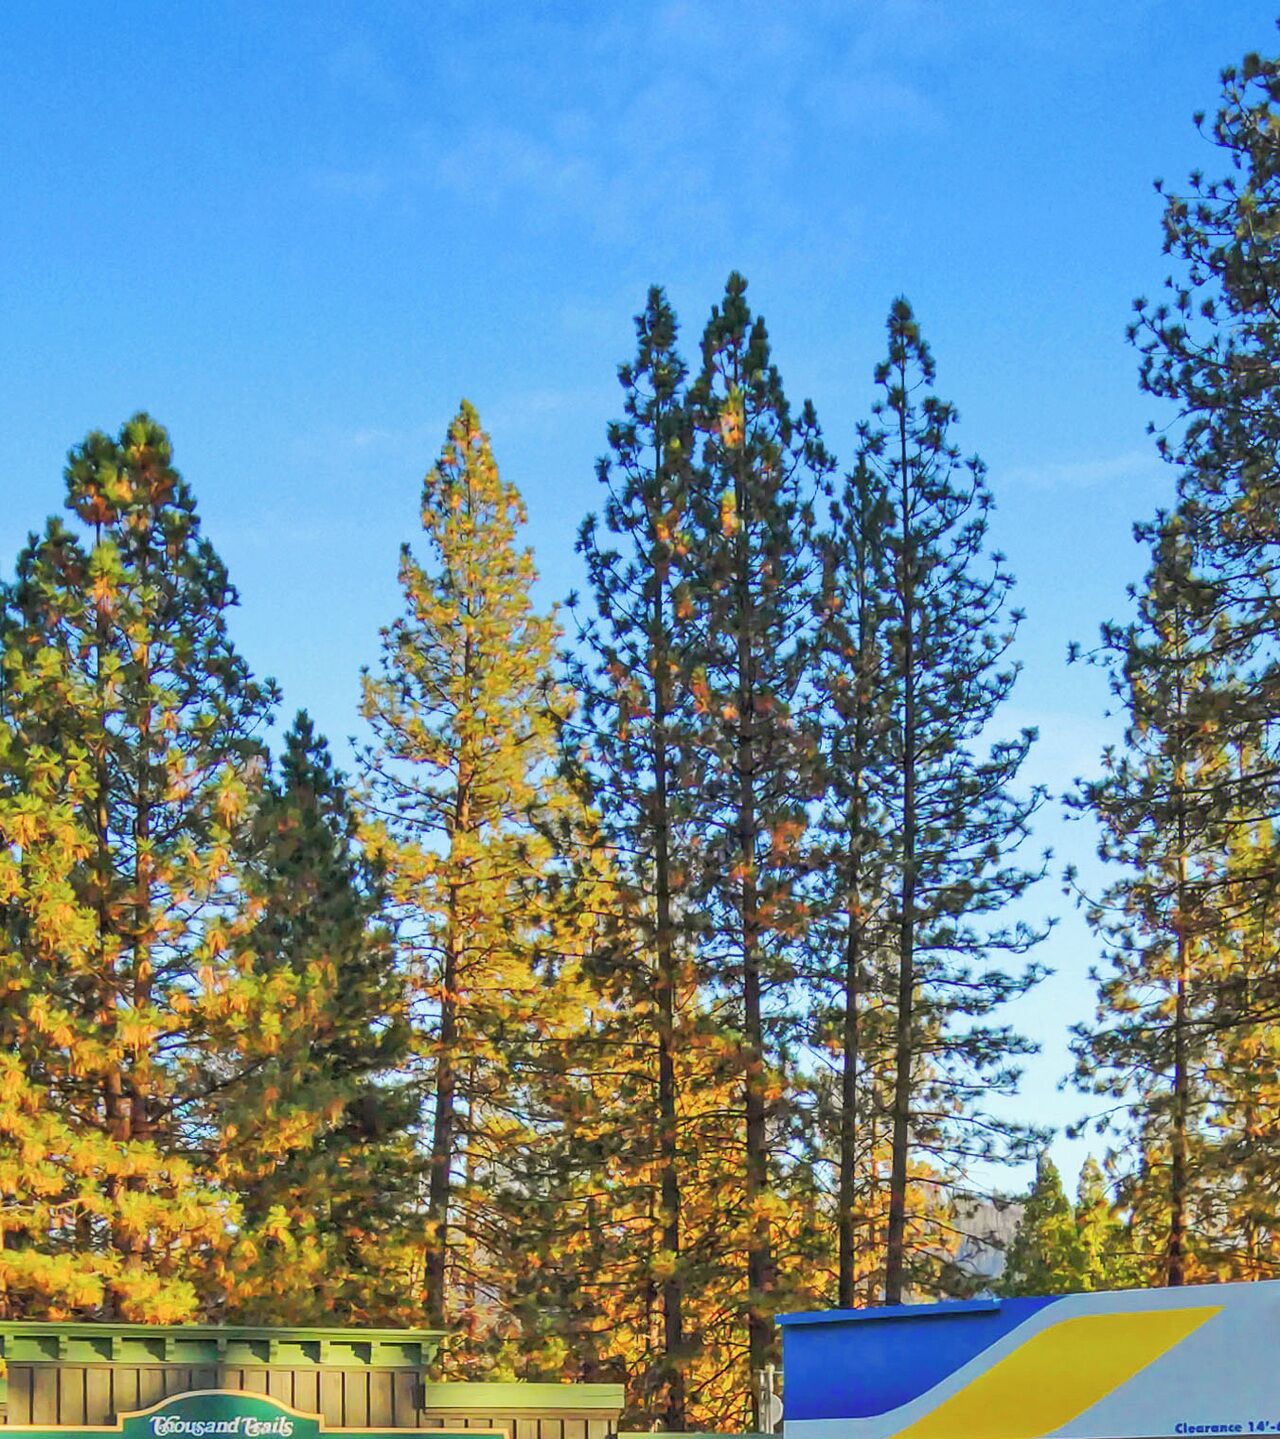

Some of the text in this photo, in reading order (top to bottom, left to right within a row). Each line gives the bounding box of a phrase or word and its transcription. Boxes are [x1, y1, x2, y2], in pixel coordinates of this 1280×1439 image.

[149, 1415, 294, 1437] Thousand Trails
[1174, 1422, 1243, 1434] Clearance
